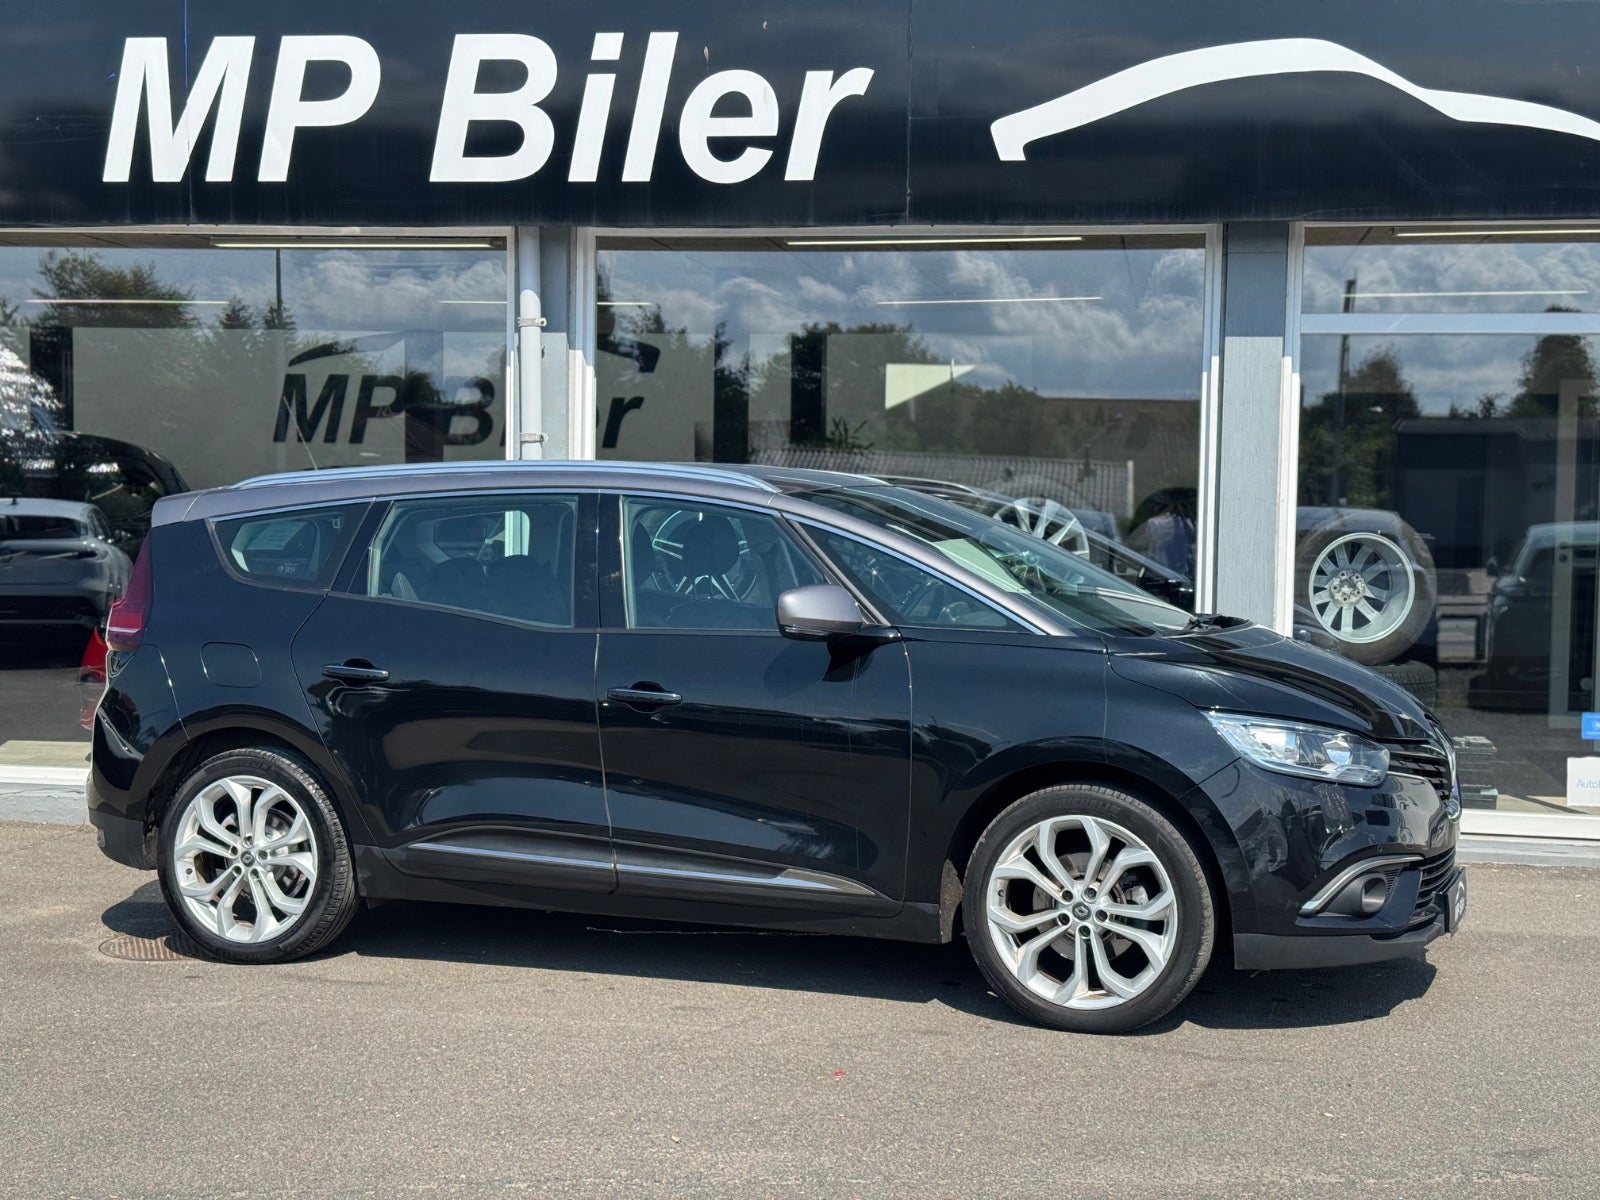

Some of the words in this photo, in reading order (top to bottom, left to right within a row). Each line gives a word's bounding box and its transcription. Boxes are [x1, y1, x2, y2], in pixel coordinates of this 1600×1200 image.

[103, 35, 381, 183] MP
[430, 31, 875, 184] Biler
[273, 373, 406, 445] MP
